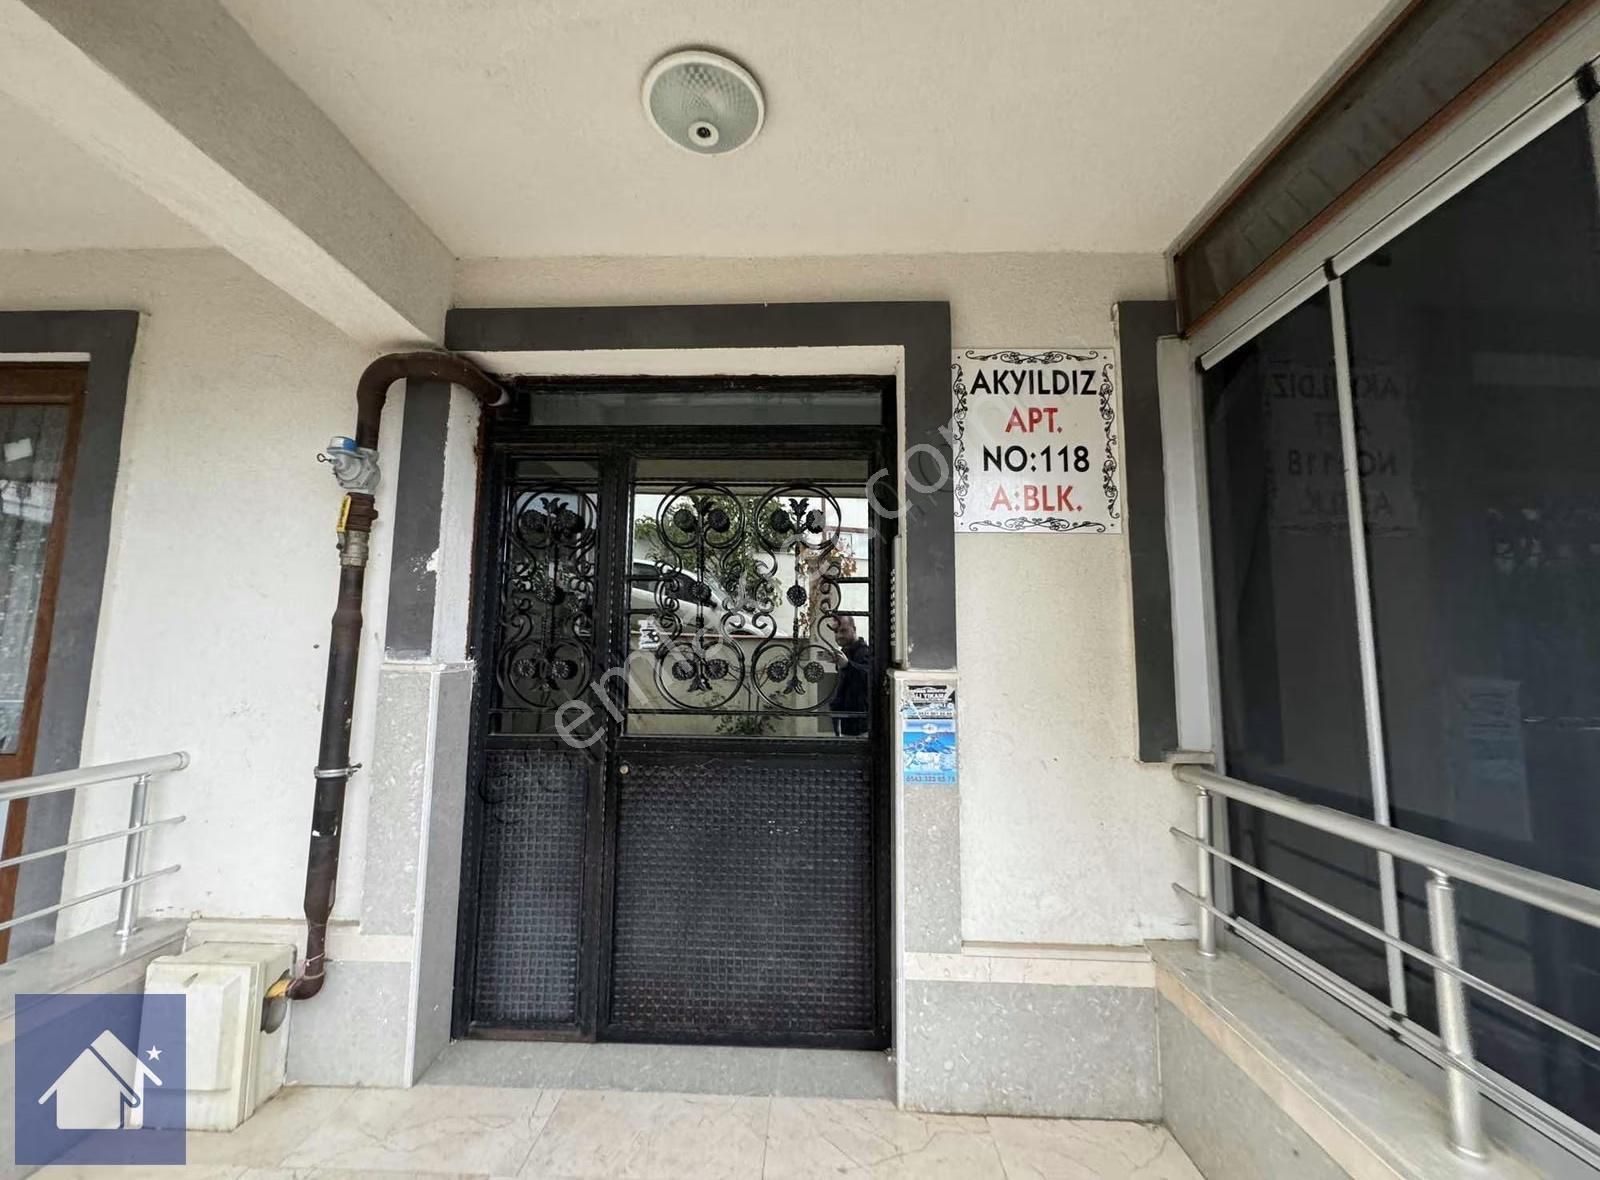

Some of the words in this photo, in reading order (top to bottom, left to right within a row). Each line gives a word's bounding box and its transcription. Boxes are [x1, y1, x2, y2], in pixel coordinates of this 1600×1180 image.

[970, 369, 1097, 395] AKYILDIZ
[1005, 406, 1063, 433] APT.
[983, 445, 1090, 473] NO:118
[990, 485, 1083, 512] A:BLK.
